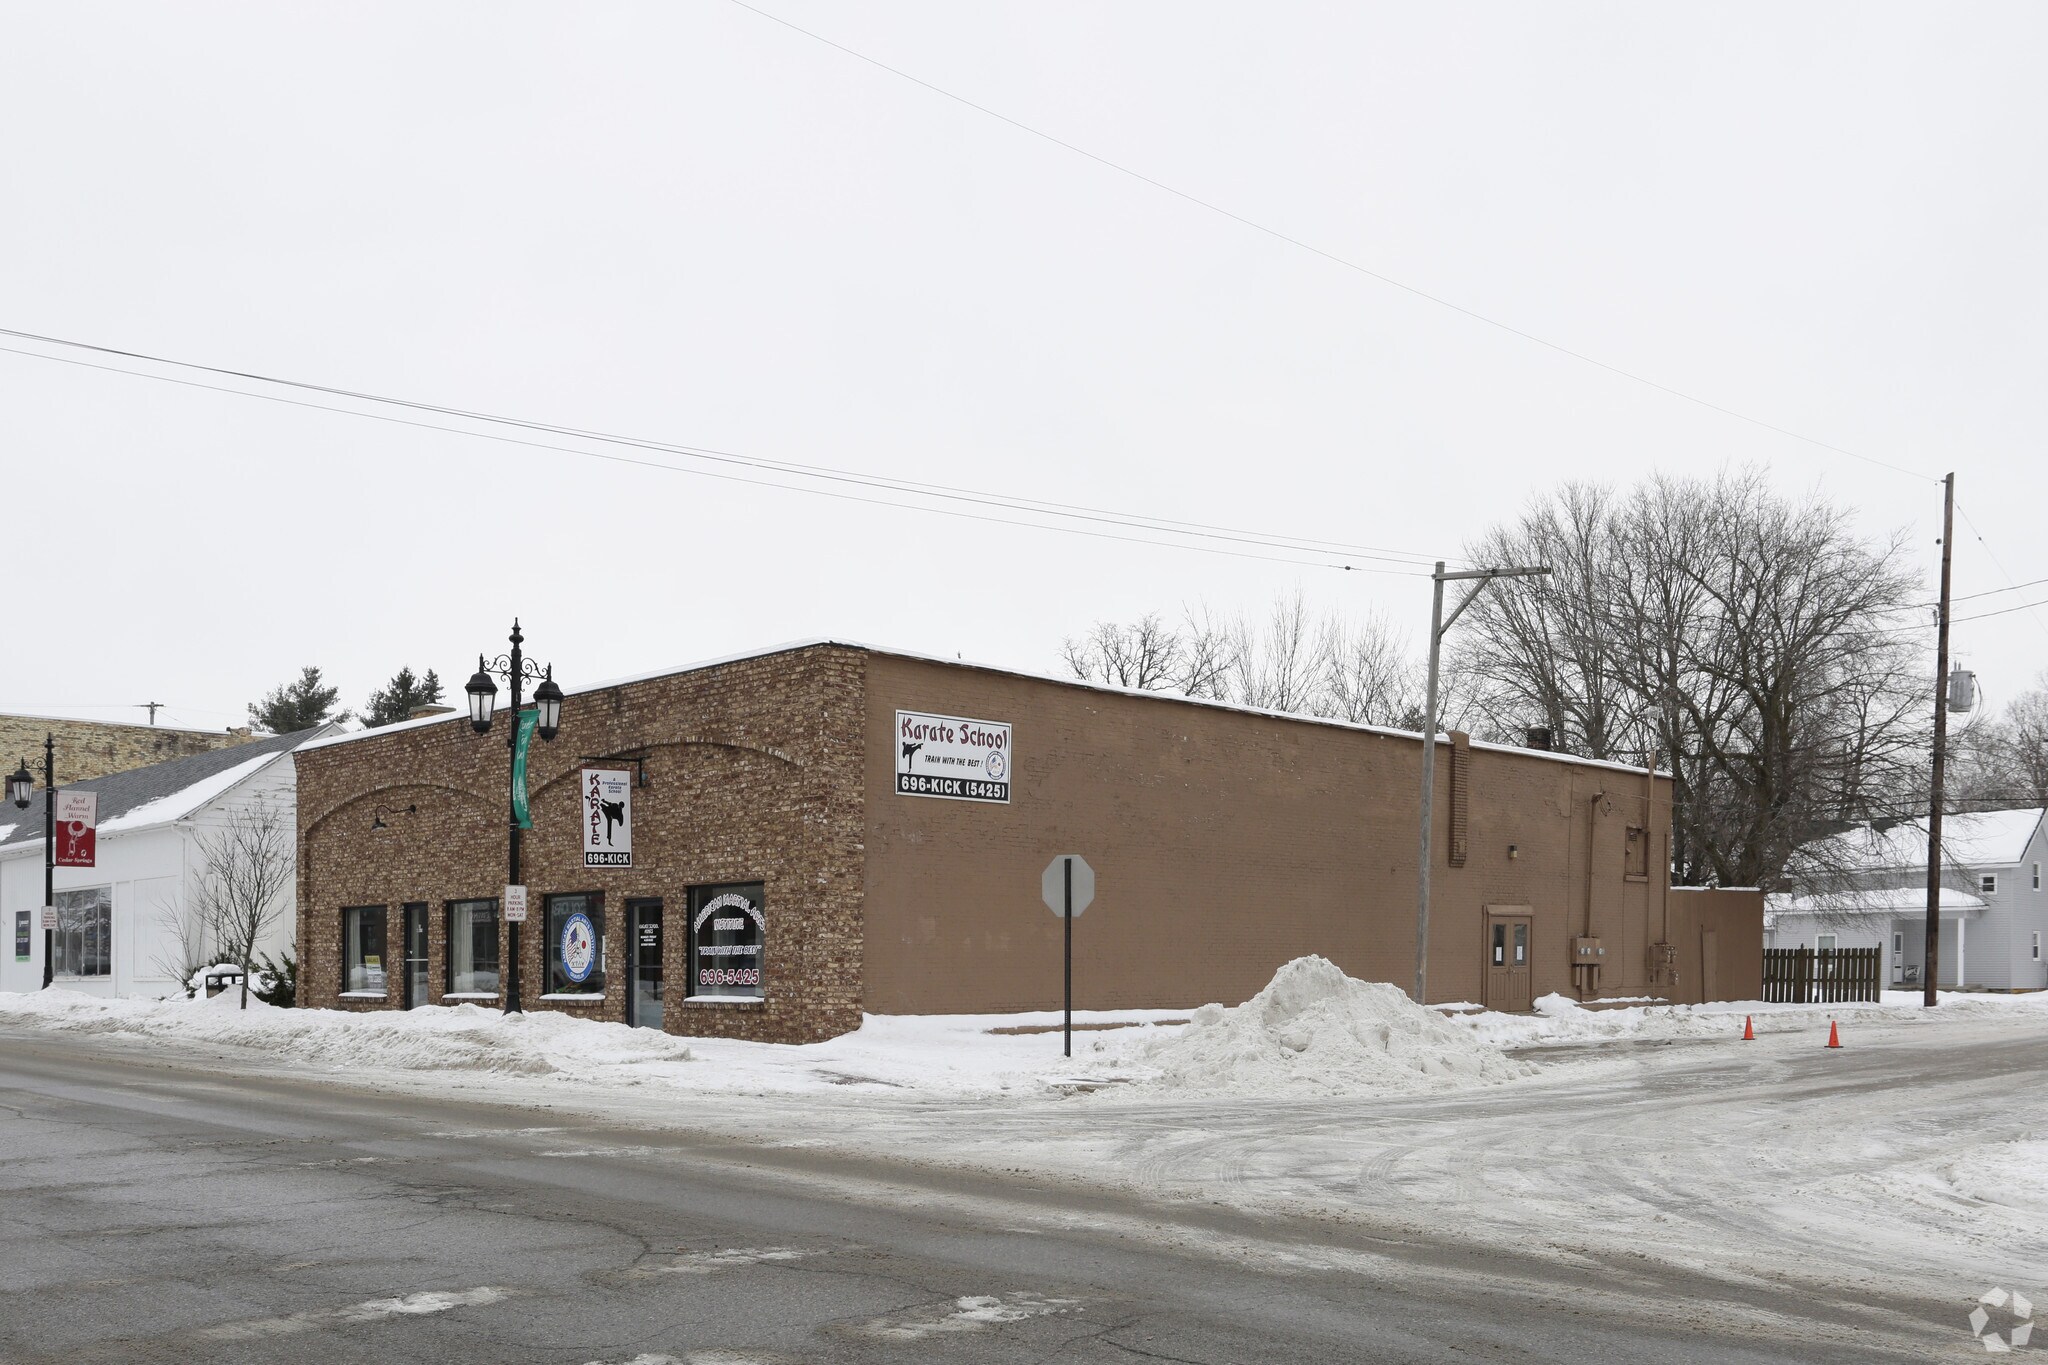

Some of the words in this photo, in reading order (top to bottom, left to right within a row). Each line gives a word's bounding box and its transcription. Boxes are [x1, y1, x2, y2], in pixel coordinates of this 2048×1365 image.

[901, 714, 954, 744] Karate
[960, 723, 1008, 751] School
[924, 755, 941, 763] TRAIN
[942, 756, 955, 765] WITH
[956, 757, 965, 766] THE
[901, 776, 961, 795] 696-KICK
[966, 781, 1005, 798] (5425)
[589, 773, 601, 846] KARATE
[587, 853, 629, 864] 696-KICK
[694, 895, 723, 934] AMERICAN
[723, 893, 750, 914] MARTIAL
[700, 969, 760, 985] 696-5425
